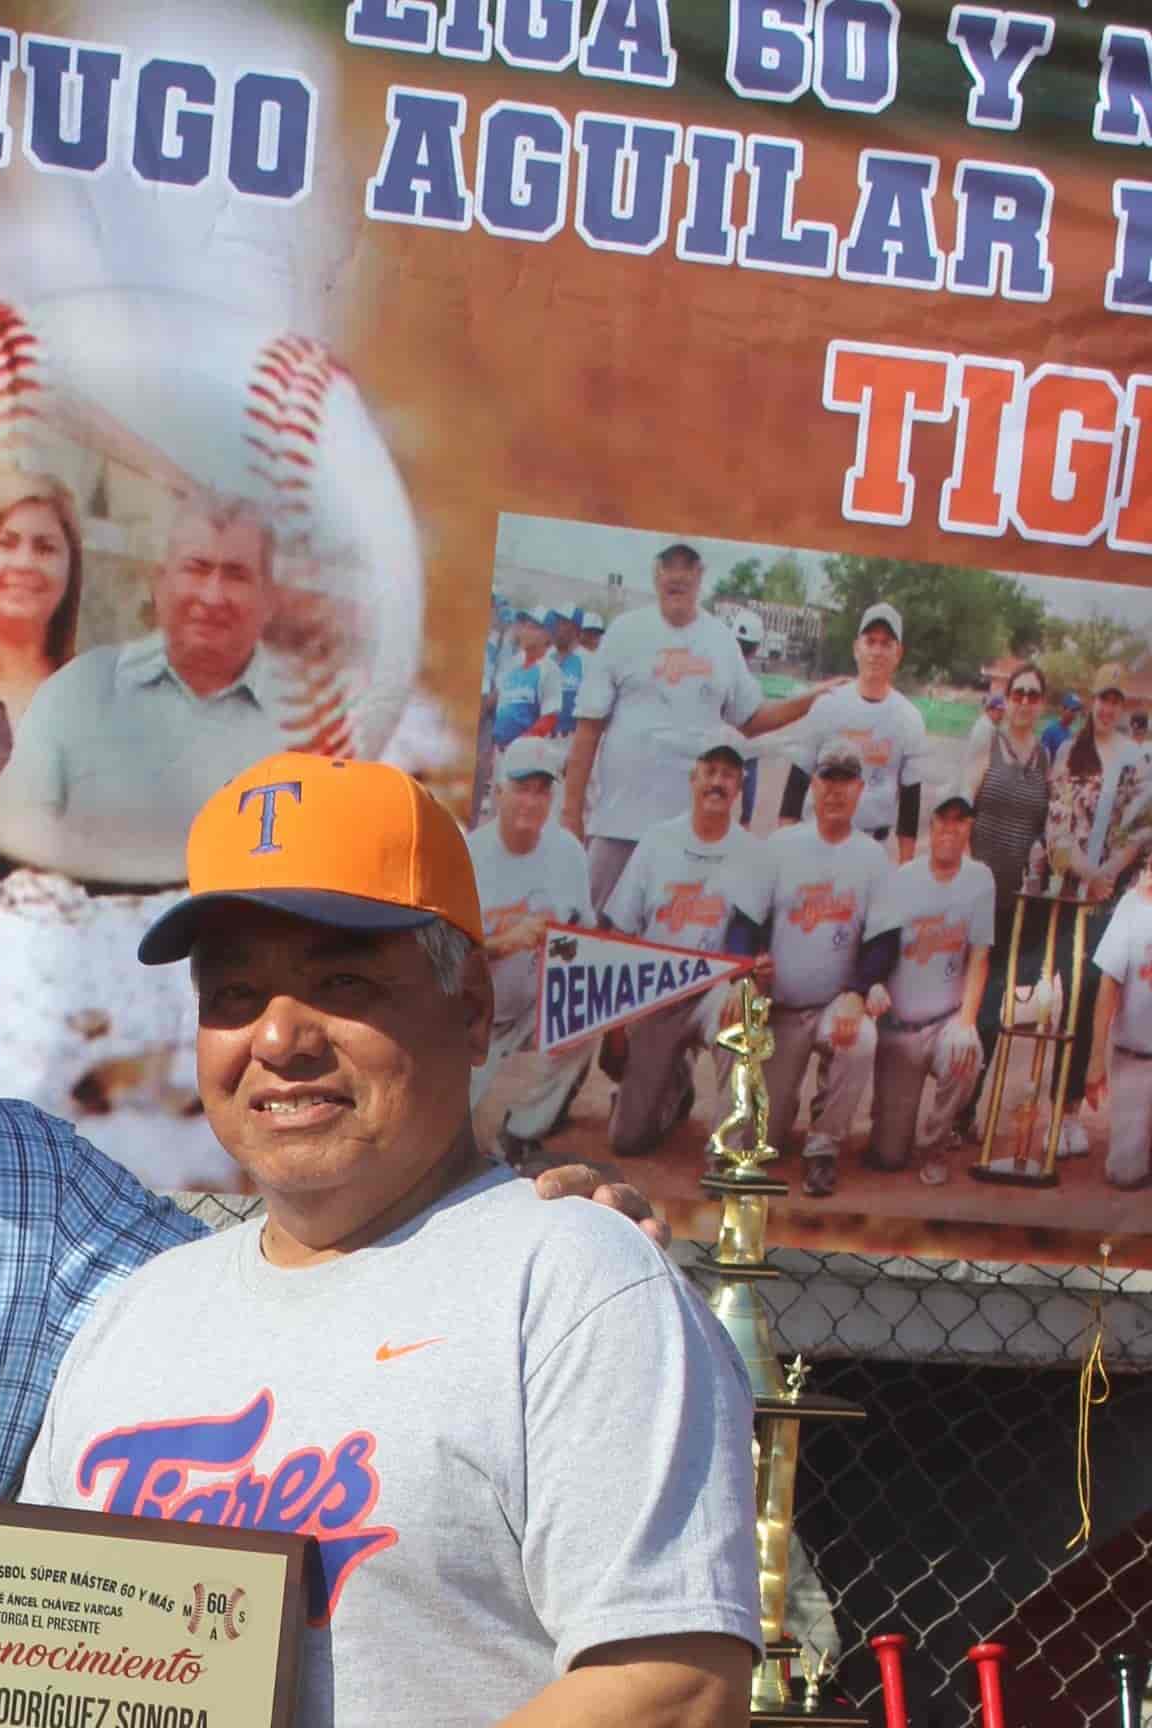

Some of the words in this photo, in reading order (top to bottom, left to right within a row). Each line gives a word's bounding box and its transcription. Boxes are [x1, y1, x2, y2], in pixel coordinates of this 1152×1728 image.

[726, 0, 900, 113] 60
[948, 4, 1054, 131] Y
[365, 85, 1054, 301] AGUILAR
[239, 780, 302, 857] T
[546, 958, 711, 1044] REMAFASA
[6, 1591, 38, 1609] ÁNGEL
[41, 1595, 81, 1613] CHÁVEZ
[83, 1602, 123, 1617] VARGAS
[30, 1565, 67, 1585] SÚPER
[70, 1570, 118, 1594] MÁSTER
[120, 1583, 136, 1598] 60
[139, 1588, 148, 1601] Y
[148, 1591, 175, 1613] MÁS
[207, 1592, 228, 1615] 60
[32, 1615, 44, 1629] EL
[47, 1616, 101, 1635] PRESENTE
